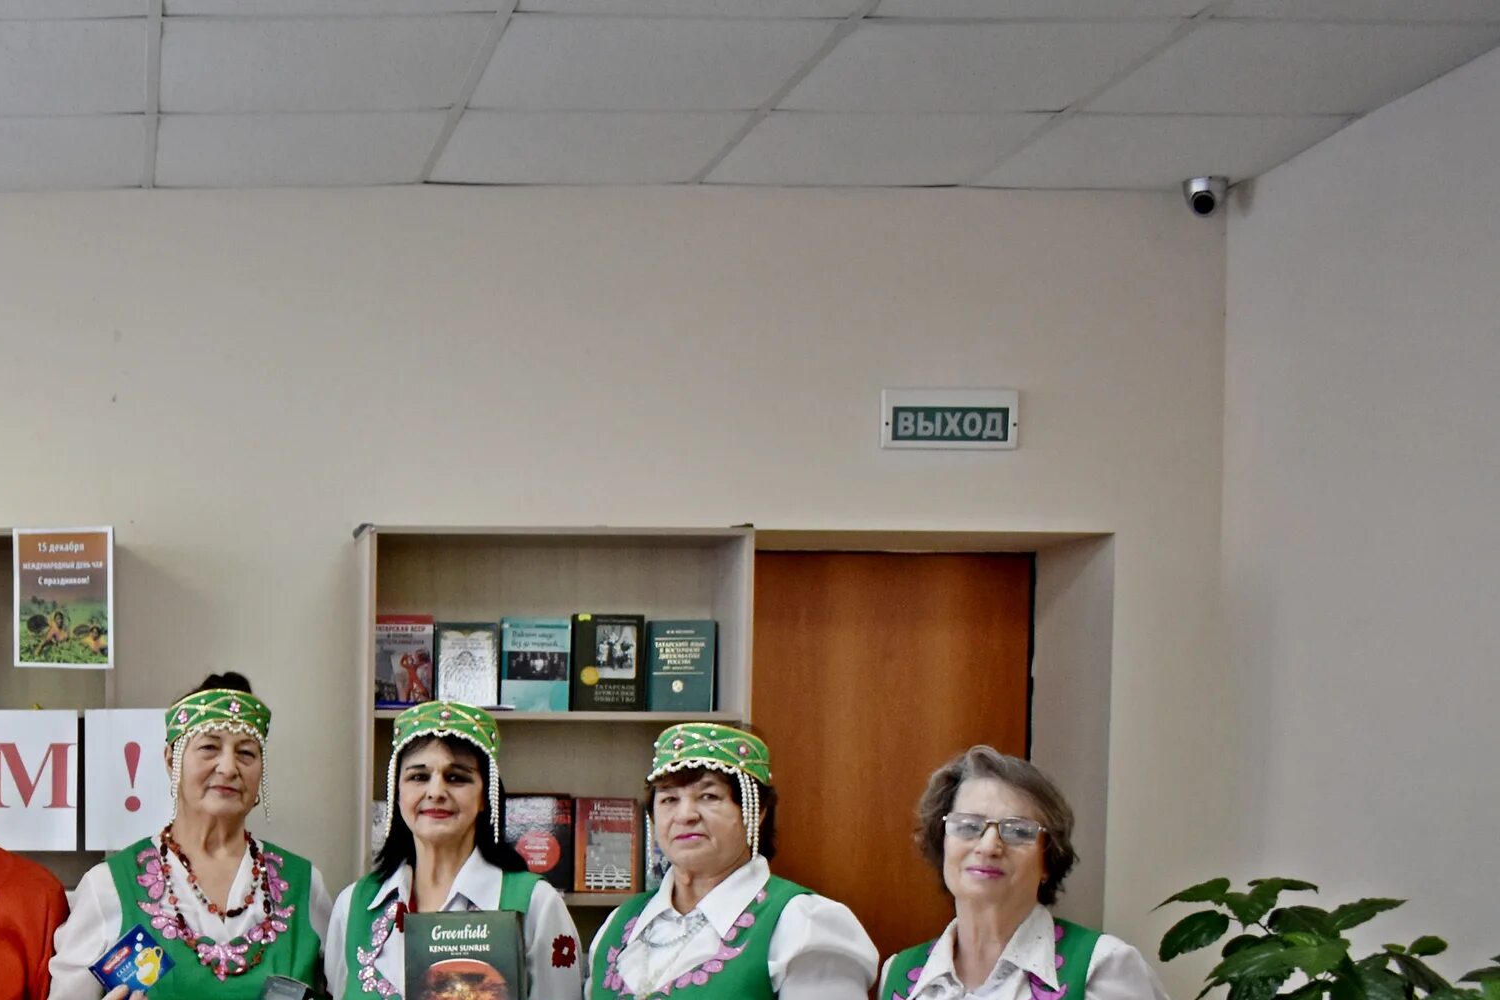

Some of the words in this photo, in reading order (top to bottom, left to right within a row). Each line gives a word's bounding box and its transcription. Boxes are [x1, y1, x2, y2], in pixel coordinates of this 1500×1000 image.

[897, 412, 1004, 439] ВЫХОД
[38, 542, 47, 552] 15
[49, 541, 85, 553] декабря
[38, 576, 43, 585] С
[44, 575, 90, 586] праздником!
[431, 923, 488, 941] Greenfield
[429, 944, 459, 953] KENYAN
[459, 943, 490, 952] SUNRISE
